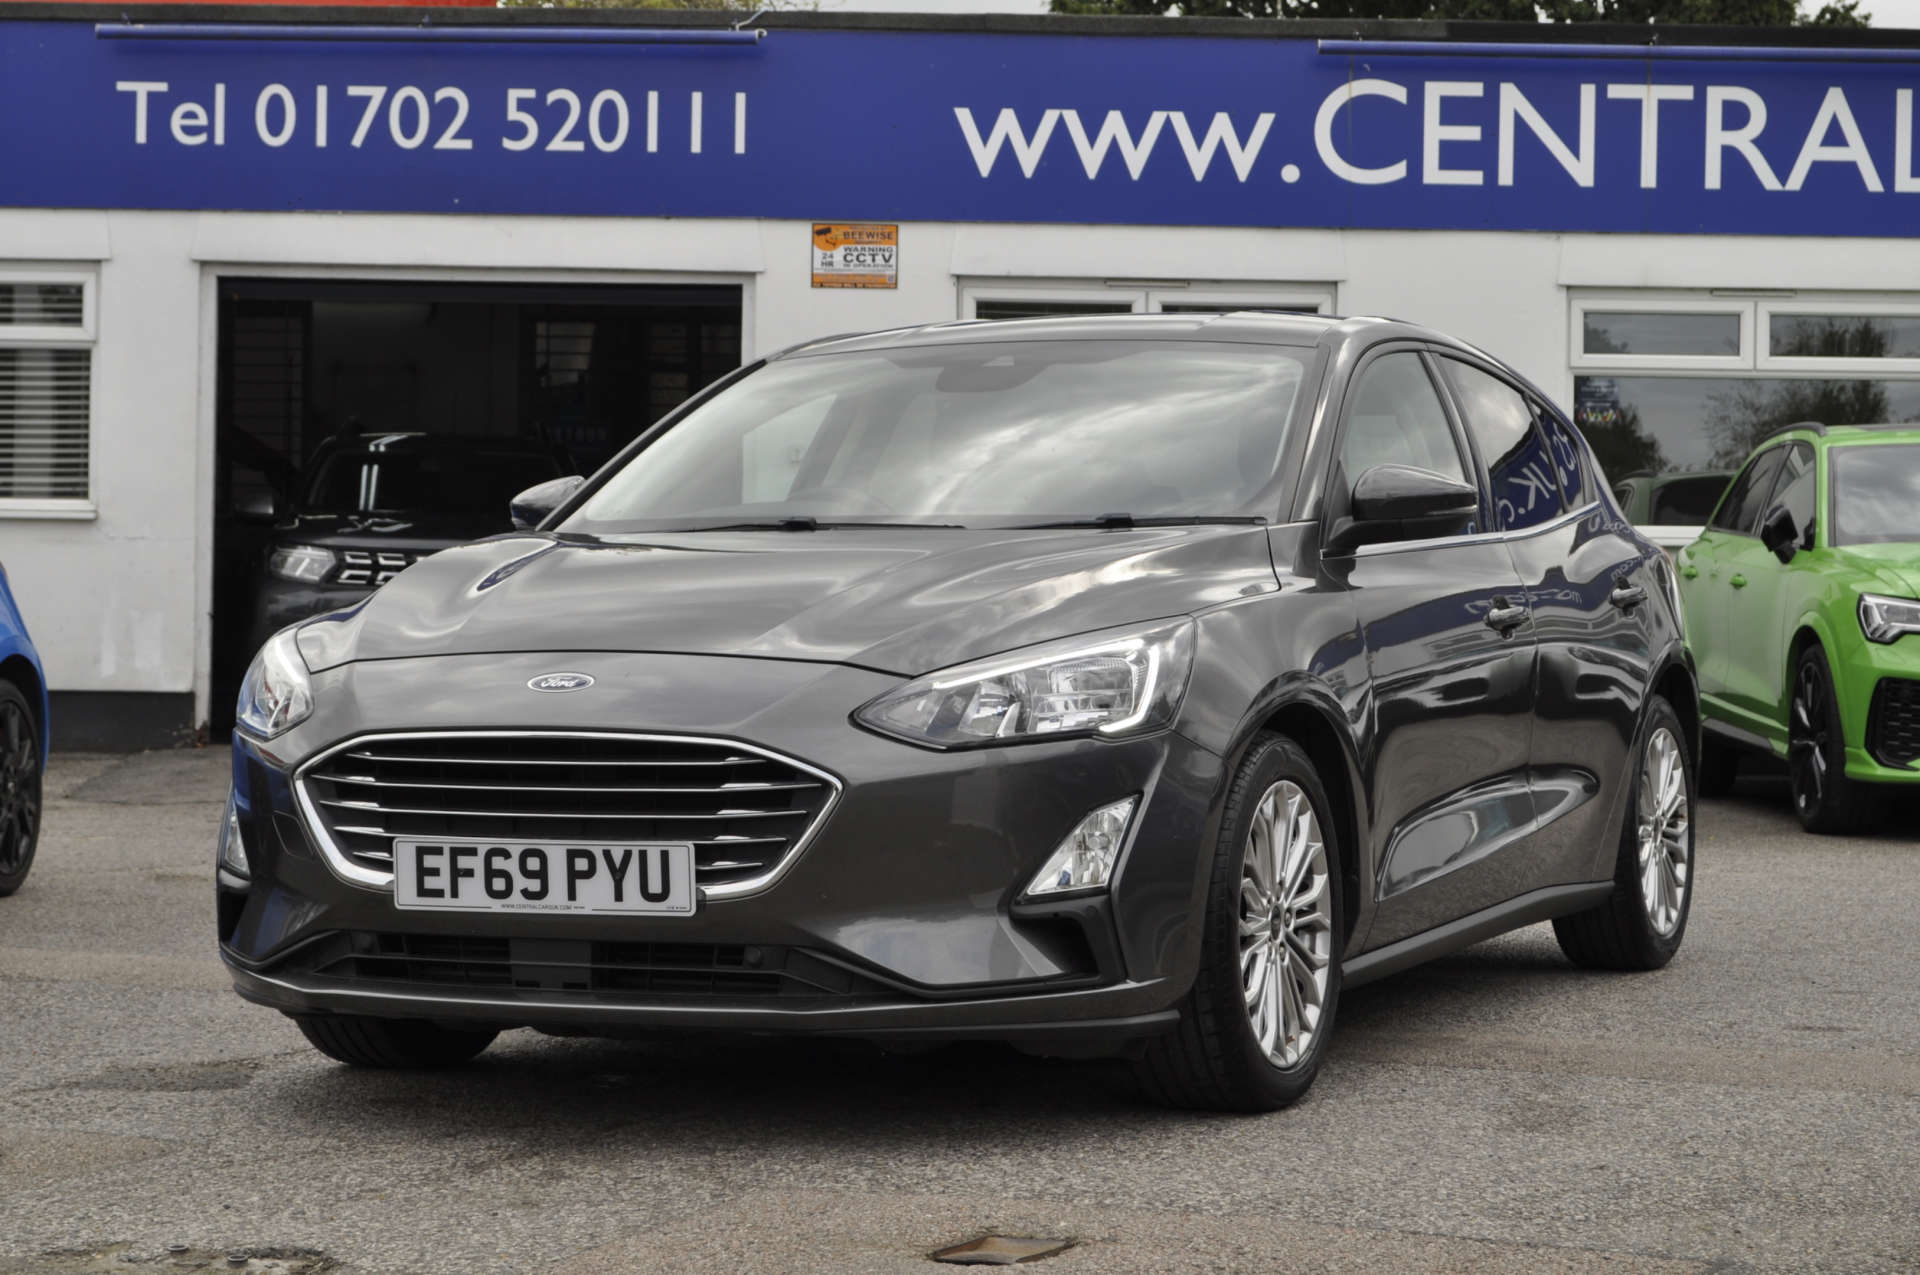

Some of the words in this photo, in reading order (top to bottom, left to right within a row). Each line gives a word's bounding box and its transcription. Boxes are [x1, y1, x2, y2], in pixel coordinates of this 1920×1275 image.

[115, 80, 225, 146] Tel
[255, 83, 473, 151] 01702
[502, 87, 748, 154] 520111
[821, 252, 834, 260] 24
[843, 253, 893, 263] CCTV
[415, 845, 549, 901] EF69
[566, 848, 671, 903] PYU
